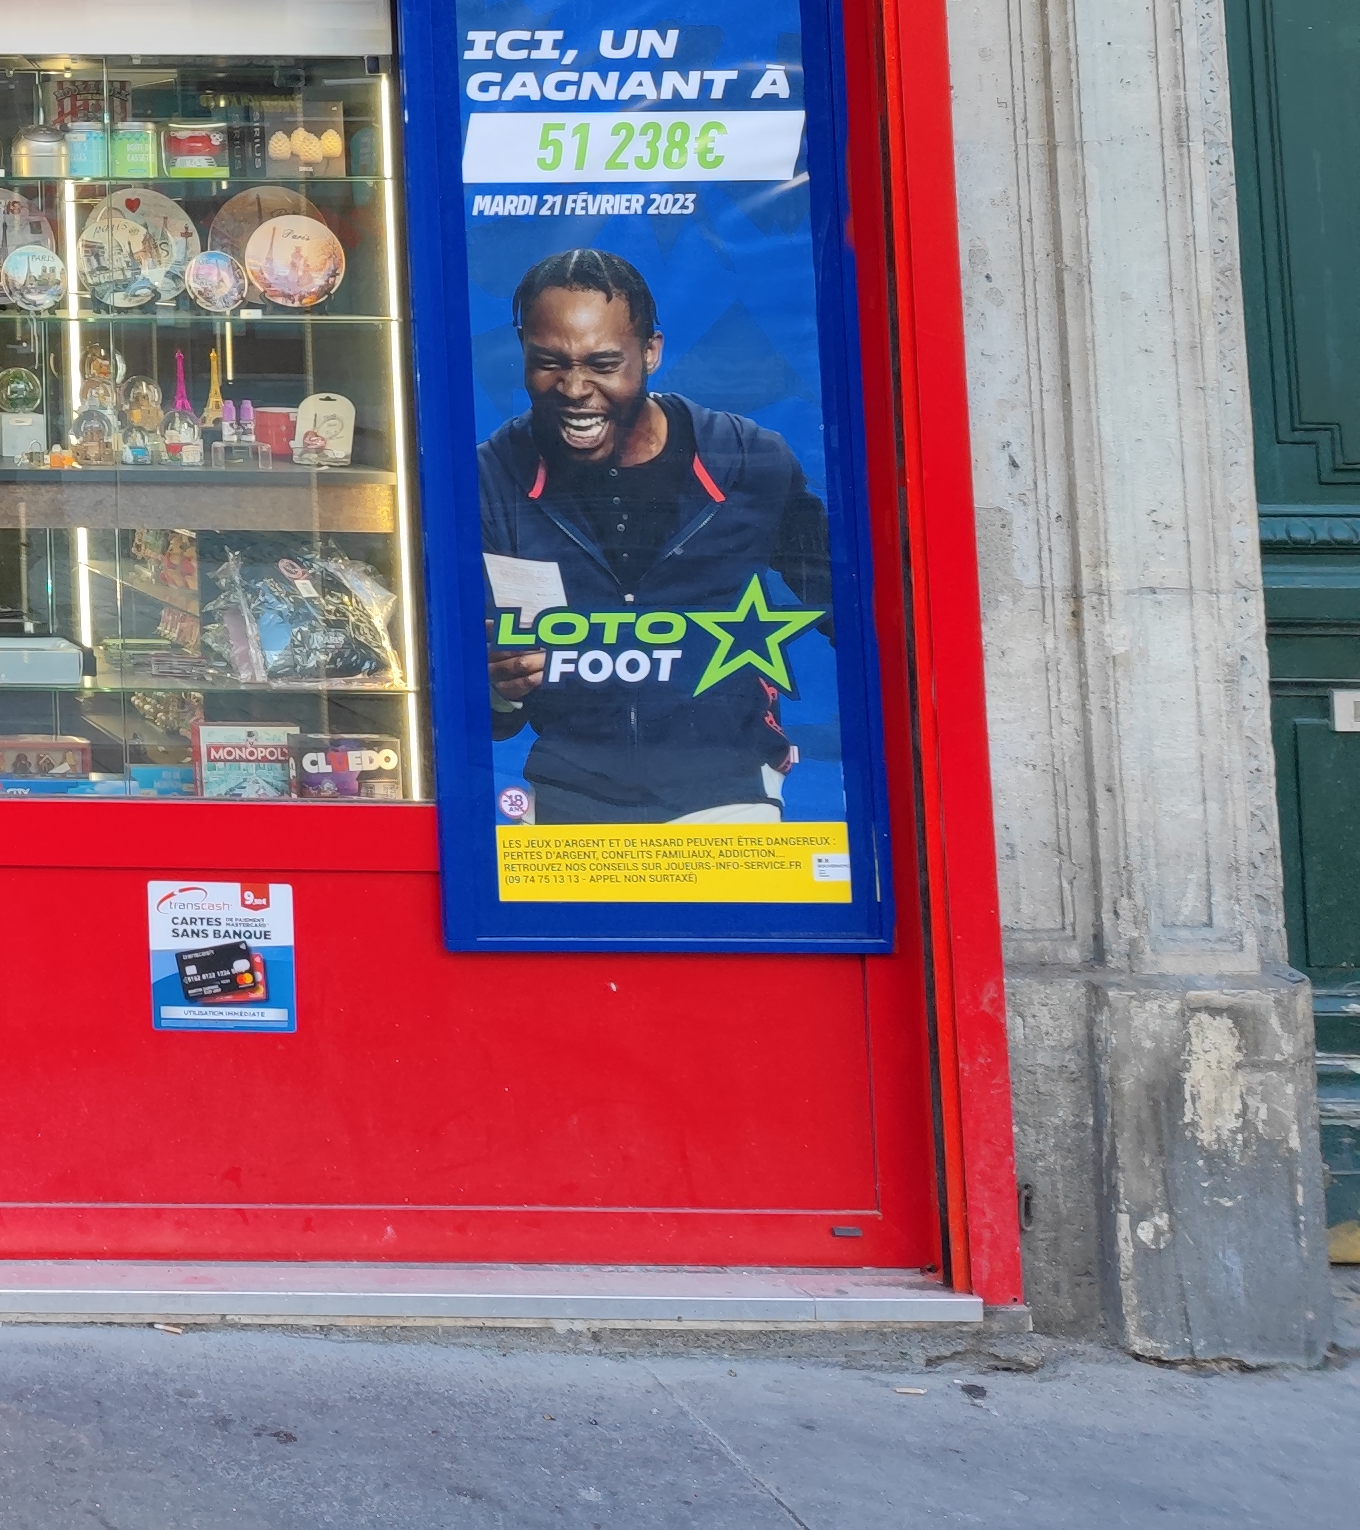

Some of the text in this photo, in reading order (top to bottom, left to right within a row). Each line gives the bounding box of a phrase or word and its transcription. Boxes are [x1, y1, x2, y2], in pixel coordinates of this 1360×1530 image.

[463, 28, 680, 66] ICI, UN
[465, 63, 791, 102] GAGNANT À
[535, 119, 728, 172] 51 238€
[472, 190, 697, 216] MARDI 21 FÉVRIER 2023
[281, 228, 312, 242] Paris
[496, 612, 688, 646] LOTO
[548, 649, 683, 684] FOOT
[301, 748, 398, 774] CLUEDO
[502, 839, 522, 849] LES
[524, 839, 552, 849] JEUX
[554, 838, 606, 848] D'ARGENT
[608, 839, 621, 848] ET
[624, 839, 638, 848] DE
[640, 838, 684, 848] HASARD
[686, 837, 736, 847] PEUVENT
[737, 835, 764, 847] ÊTRE
[766, 836, 831, 847] DANGEREUX
[503, 850, 543, 861] PERTES
[545, 850, 600, 861] D'ARGENT,
[601, 850, 653, 860] CONFLITS
[655, 849, 716, 860] FAMILIAUX,
[504, 860, 802, 872] RETROUVEZ NOS CONSEILS SUR JOUEURS-INFO-SERVICE.FR
[505, 875, 521, 885] (09
[524, 875, 536, 884] 74
[538, 875, 550, 884] 75
[553, 875, 565, 884] 13
[568, 875, 580, 884] 13
[589, 874, 622, 884] APPEL
[624, 874, 647, 883] NON
[648, 872, 698, 884] SURTAXÉ)
[169, 900, 230, 912] transcash
[171, 916, 222, 927] CARTES
[171, 928, 272, 940] SANS BANQUE
